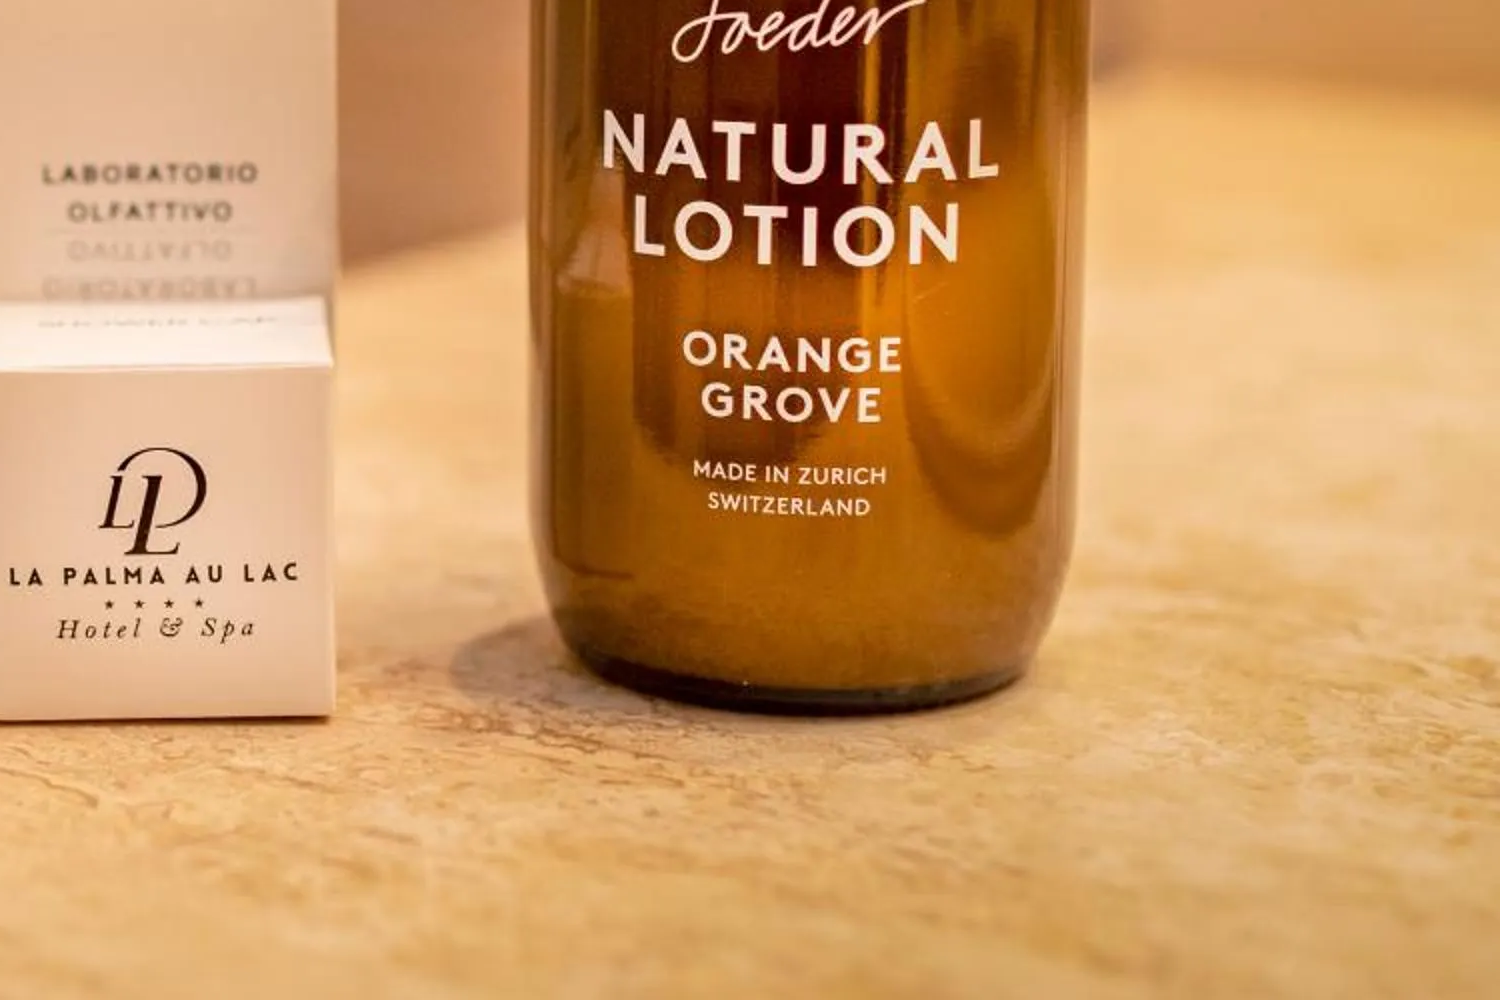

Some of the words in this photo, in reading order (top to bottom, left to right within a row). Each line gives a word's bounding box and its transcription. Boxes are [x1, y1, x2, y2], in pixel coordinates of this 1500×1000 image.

[603, 109, 999, 185] NATURAL
[42, 163, 258, 185] LABORATORIO
[67, 200, 233, 223] OLFATTIVO
[634, 194, 959, 268] LOTION
[682, 330, 901, 374] ORANGE
[701, 381, 881, 423] GROVE
[693, 459, 757, 482] MADE
[765, 465, 789, 484] IN
[798, 467, 887, 485] ZURICH
[707, 491, 871, 517] SWITZERLAND
[9, 567, 43, 586] LA
[63, 566, 165, 586] PALMA
[185, 564, 223, 584] AU
[243, 562, 298, 583] LAC
[57, 617, 141, 640] Hotel
[159, 617, 184, 638] &
[200, 617, 254, 645] Spa
